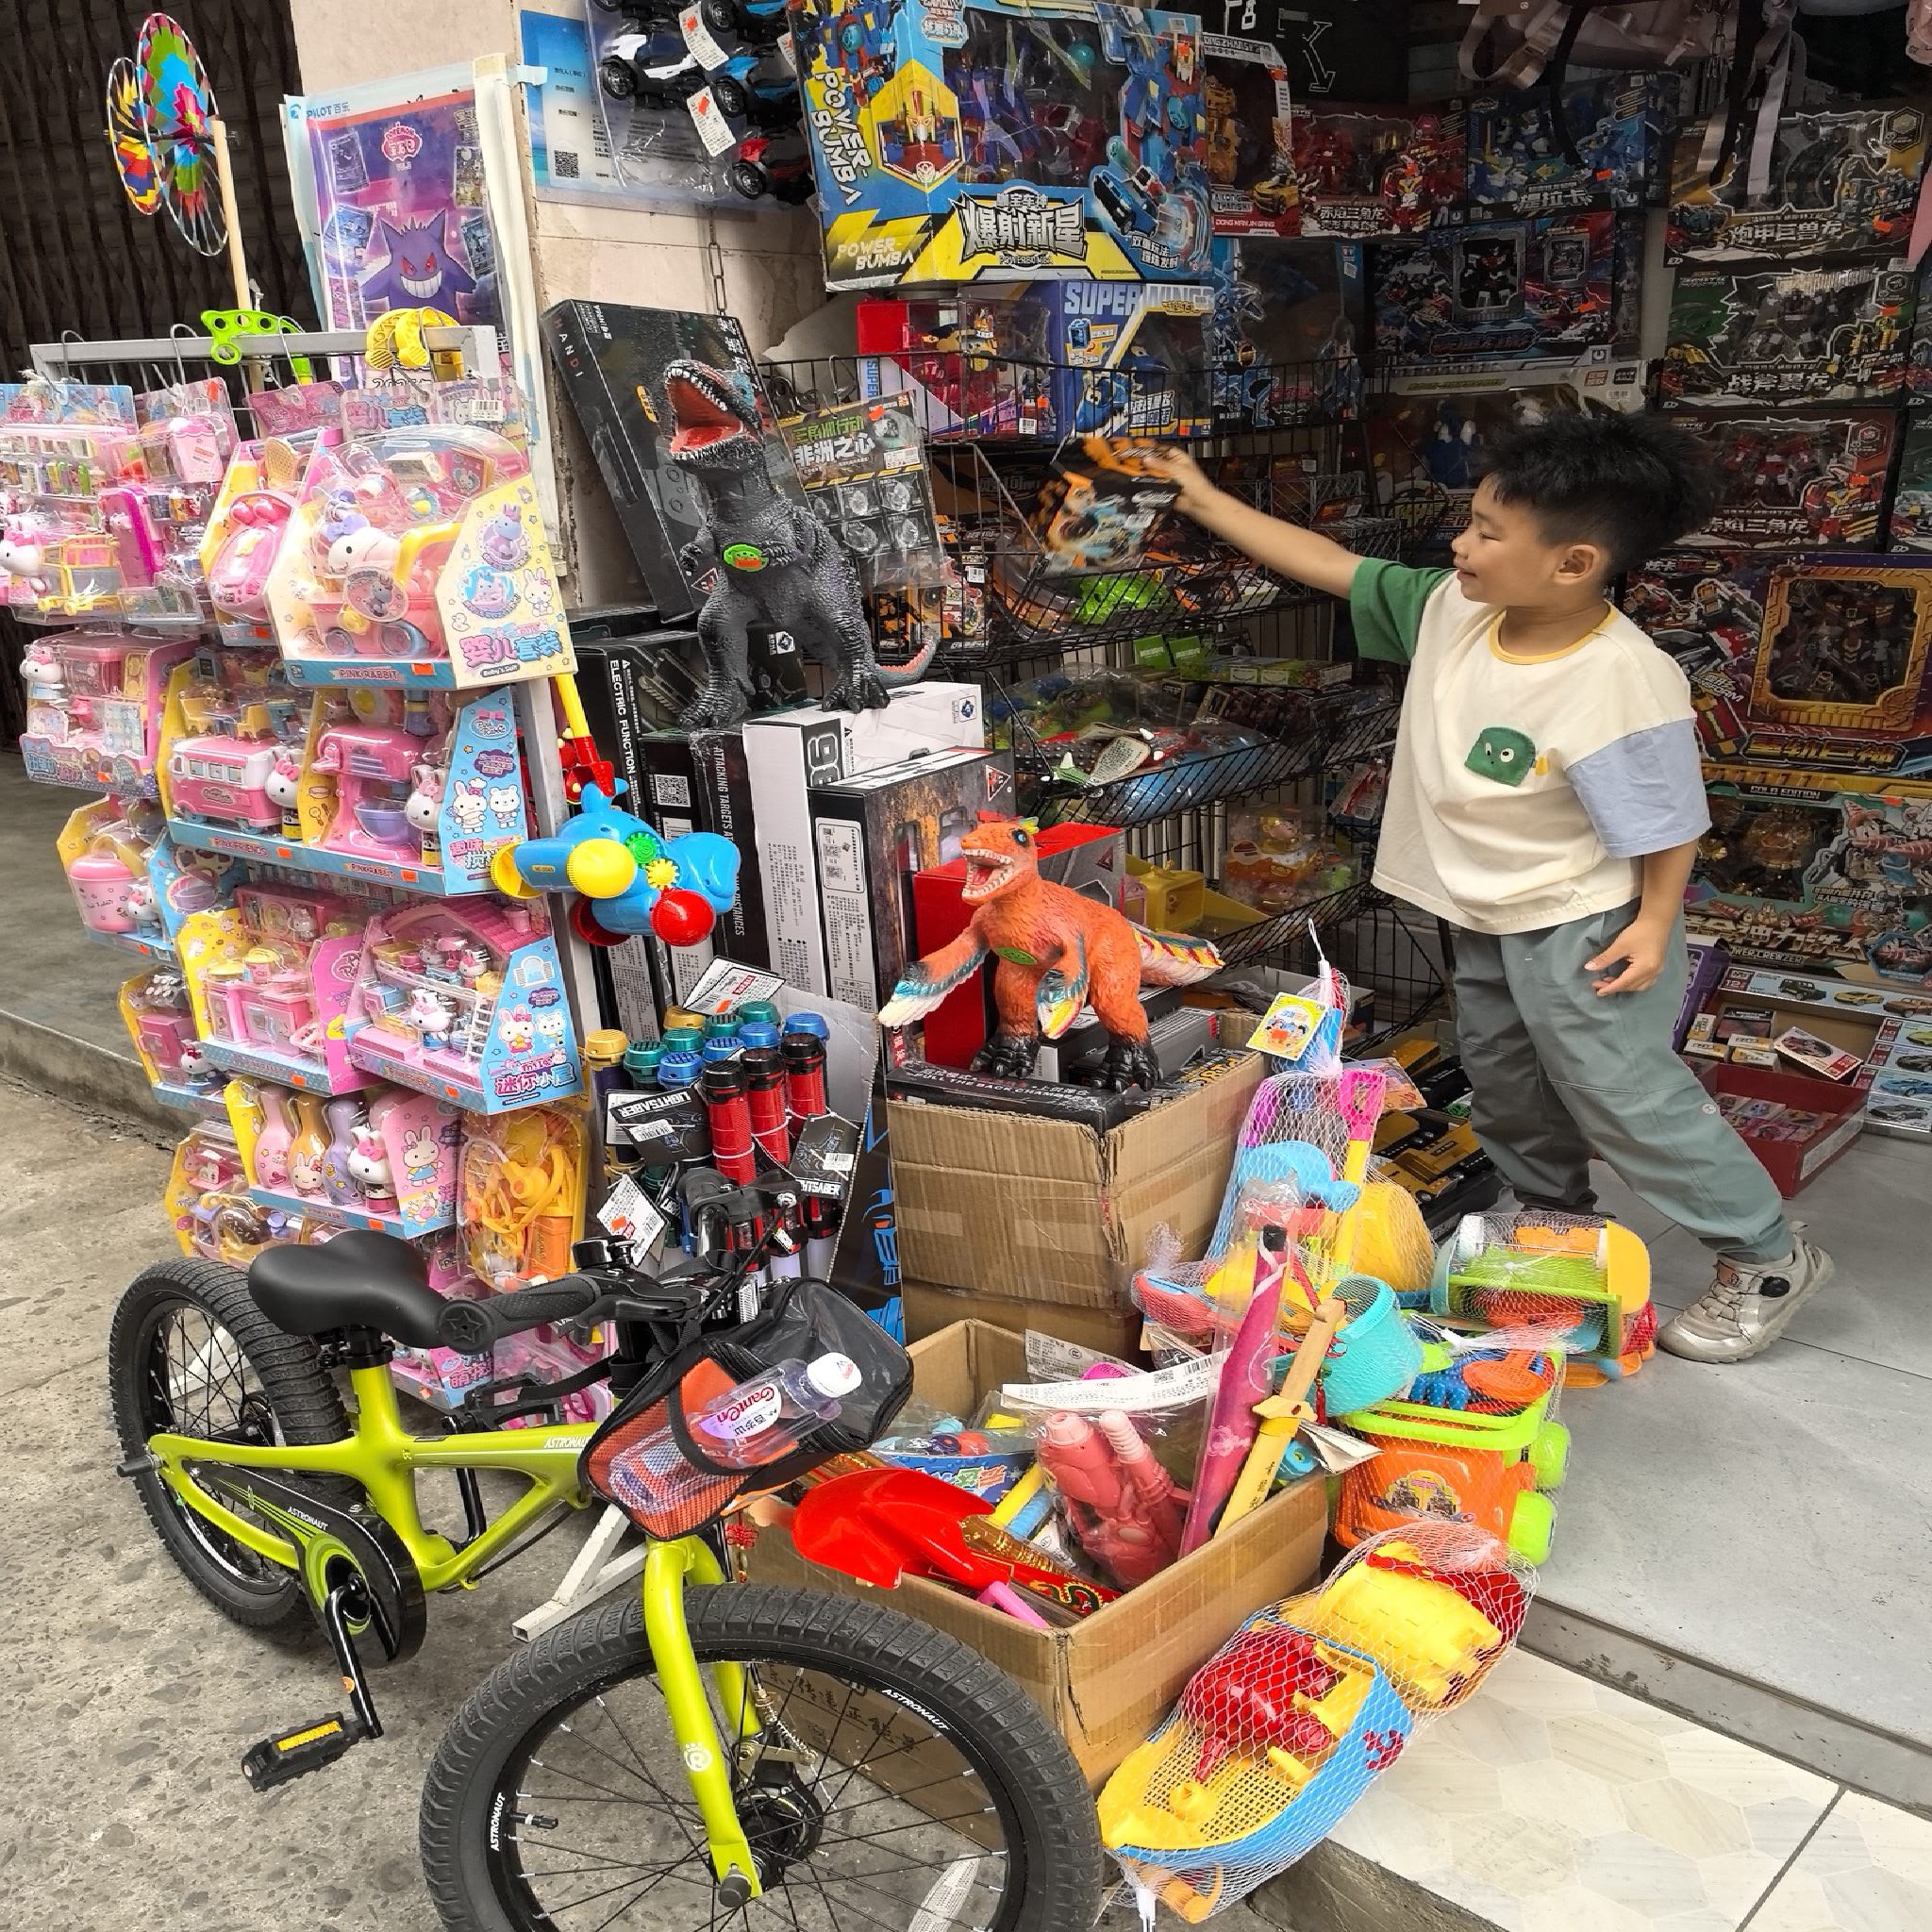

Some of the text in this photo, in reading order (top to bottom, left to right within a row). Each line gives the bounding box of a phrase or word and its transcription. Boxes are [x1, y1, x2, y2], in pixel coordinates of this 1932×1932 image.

[307, 105, 332, 118] PILOT
[963, 200, 1088, 256] 爆射新星
[855, 249, 915, 272] BUMBA
[1063, 281, 1142, 316] SUPER
[866, 359, 880, 400] SUPER
[792, 415, 865, 443] 三角洲行动
[793, 431, 876, 468] 非洲之心
[459, 629, 564, 669] 婴儿套装
[610, 659, 637, 774] ELECTRIC FUNCTION
[713, 746, 729, 794] ATTACKING
[1750, 785, 1822, 800] GOLD EDITION
[719, 796, 733, 832] TARGETS
[449, 838, 483, 858] 趣味
[494, 1063, 576, 1097] 迷你小屋
[914, 1072, 946, 1082] PULL
[948, 1077, 972, 1087] THE
[618, 1090, 692, 1119] LIGHTSABER
[800, 1179, 841, 1196] HTSABER
[735, 1413, 767, 1437] 百岁山
[544, 1436, 592, 1449] ASTRONAU
[287, 1506, 329, 1530] ASTRONAUT
[881, 1688, 951, 1731] ASTRONAUT
[490, 1791, 506, 1851] ASTRONAUT
